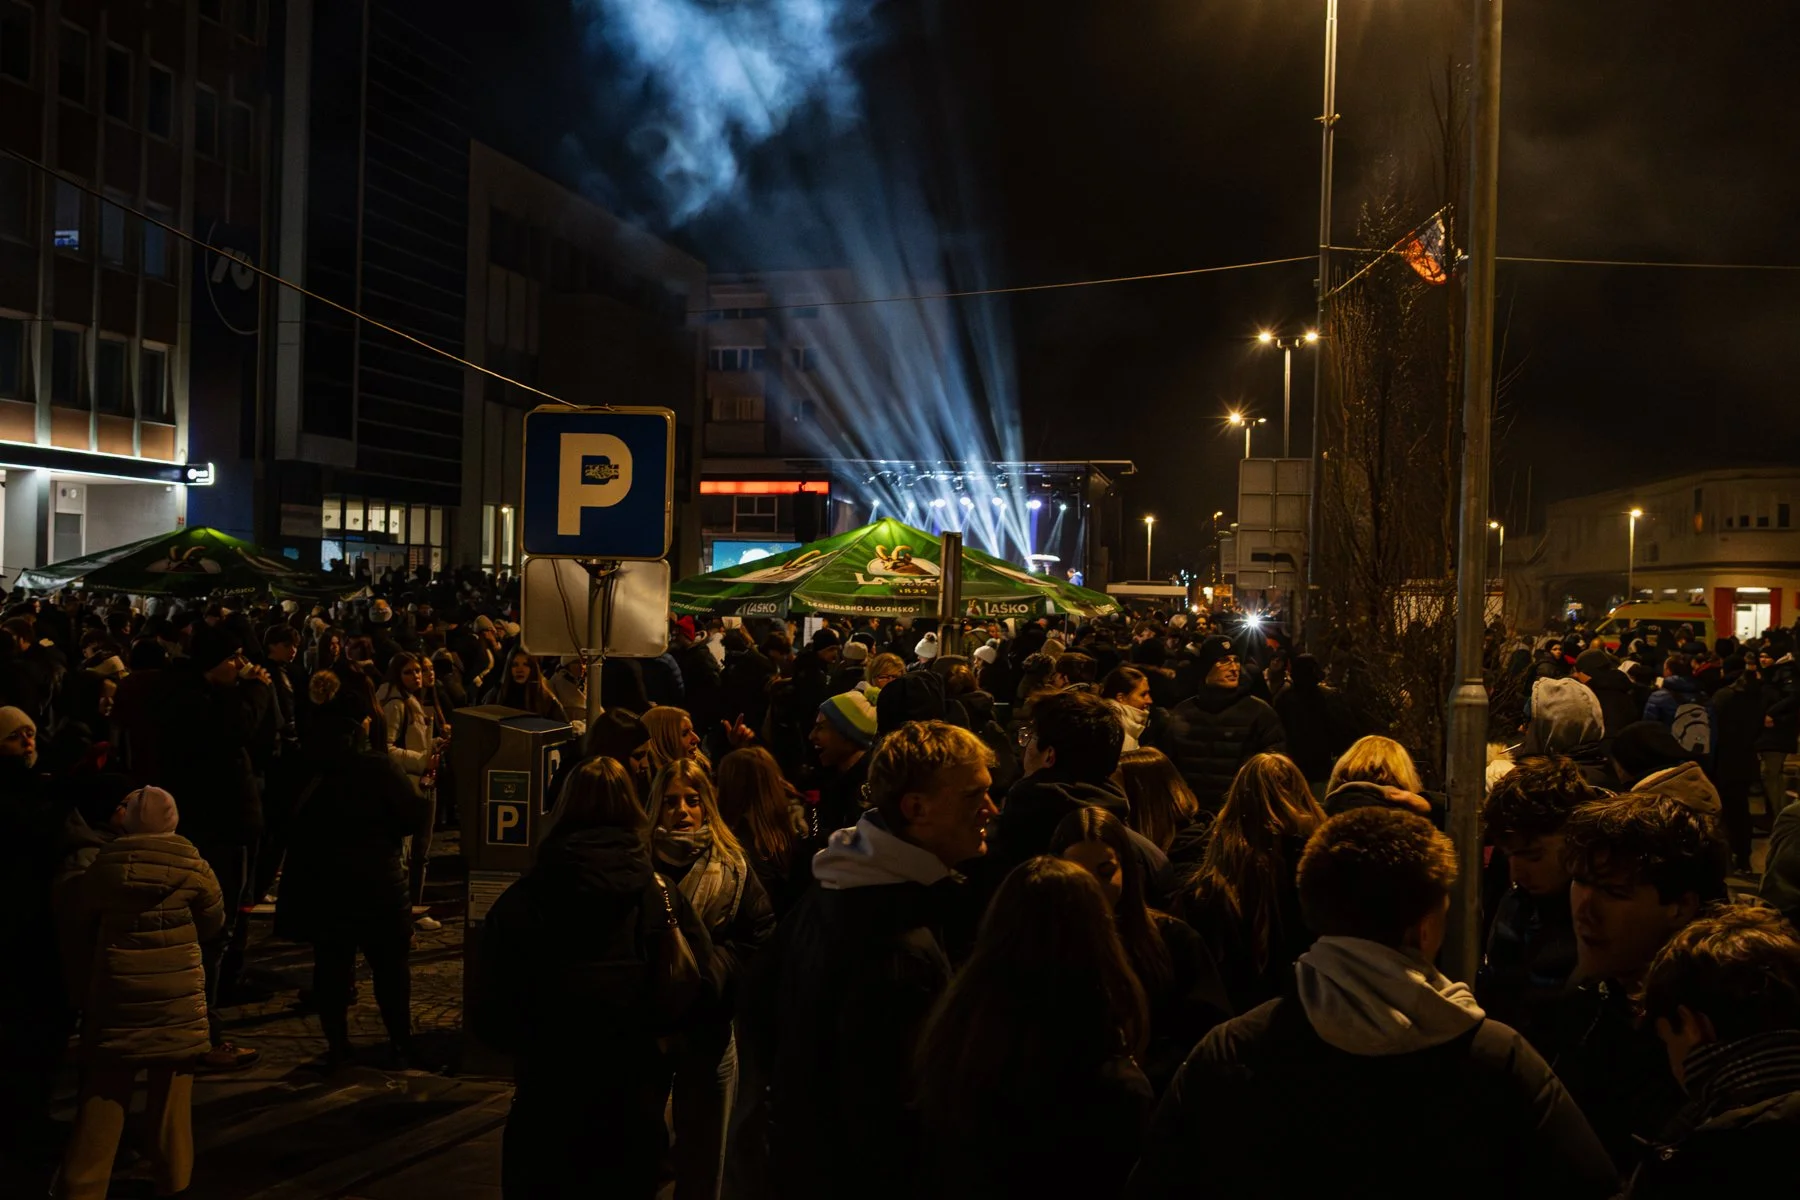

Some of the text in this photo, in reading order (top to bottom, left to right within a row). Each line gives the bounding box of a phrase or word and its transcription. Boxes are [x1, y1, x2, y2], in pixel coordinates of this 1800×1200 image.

[556, 432, 634, 537] P
[865, 605, 914, 613] SLOVENSKO
[497, 805, 519, 840] P
